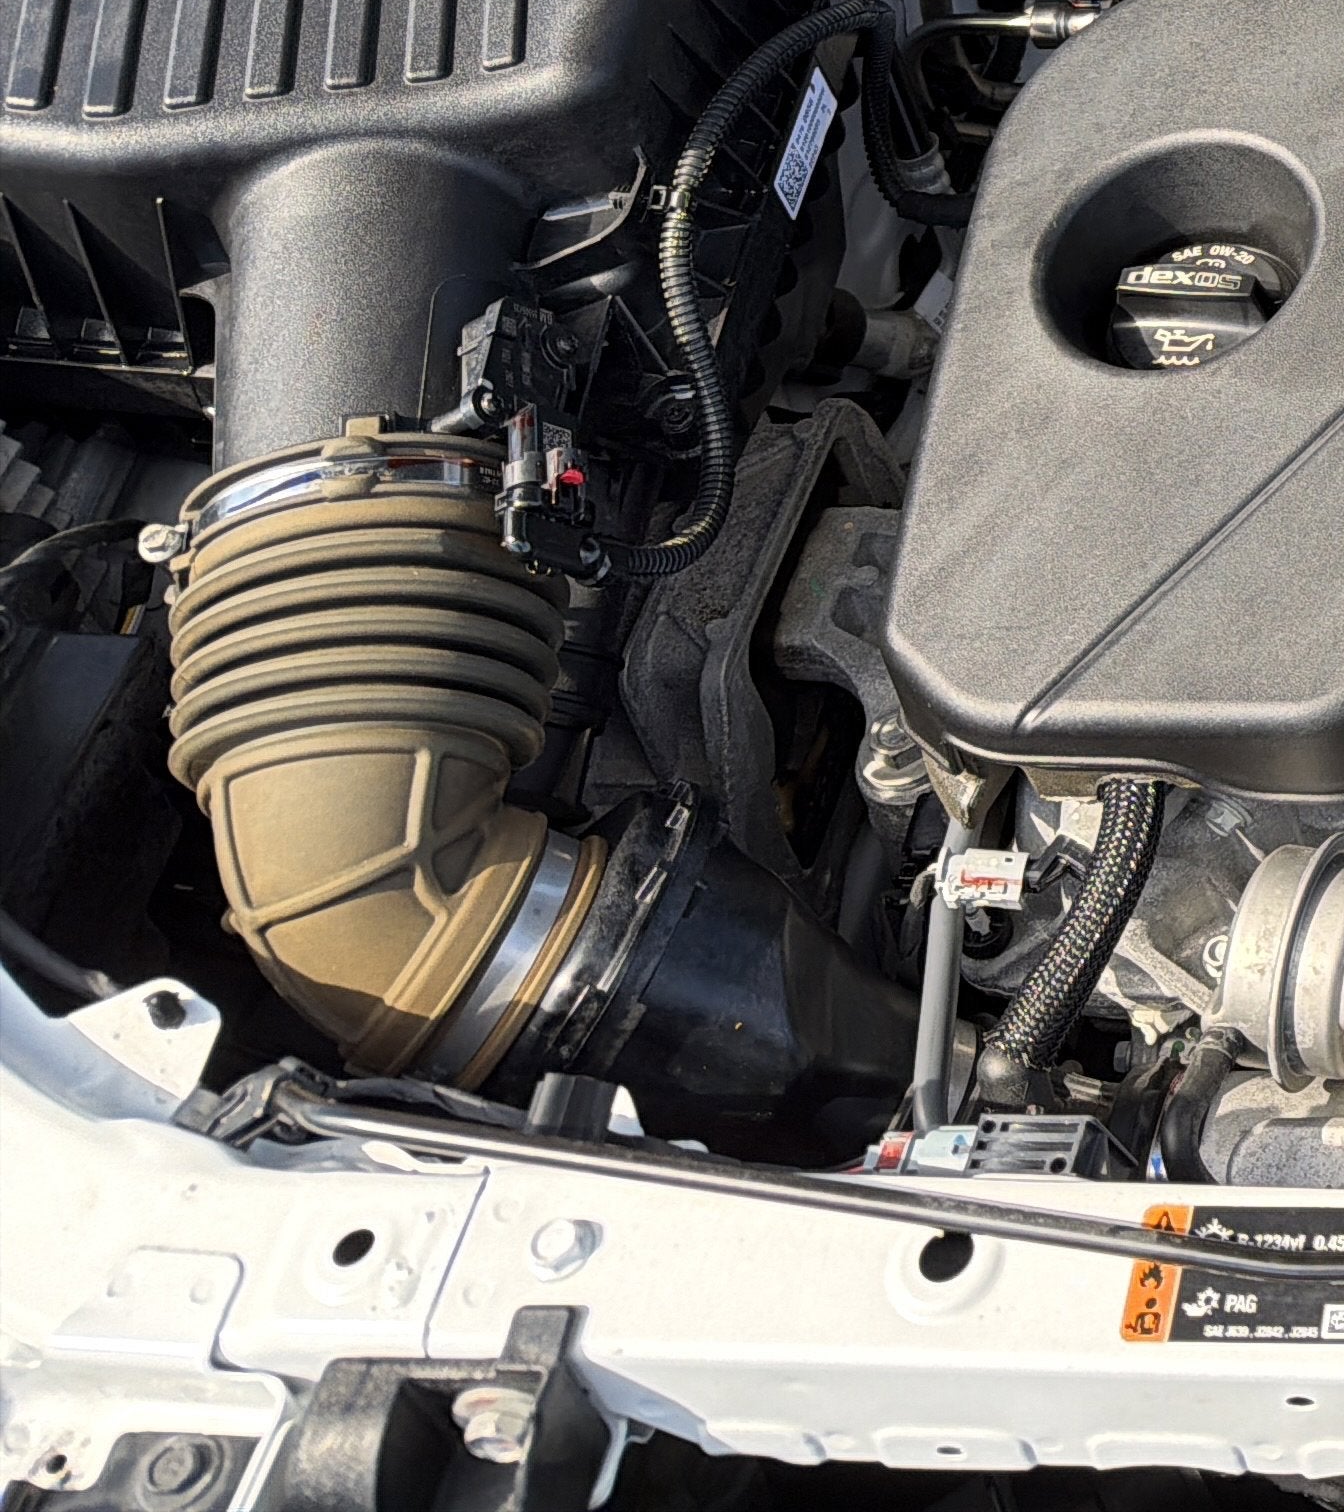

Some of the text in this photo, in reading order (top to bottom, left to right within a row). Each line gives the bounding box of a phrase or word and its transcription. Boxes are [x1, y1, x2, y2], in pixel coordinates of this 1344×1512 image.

[1172, 245, 1256, 266] SAE 0W-20
[1126, 267, 1242, 290] dexos
[1224, 1294, 1258, 1314] PAG
